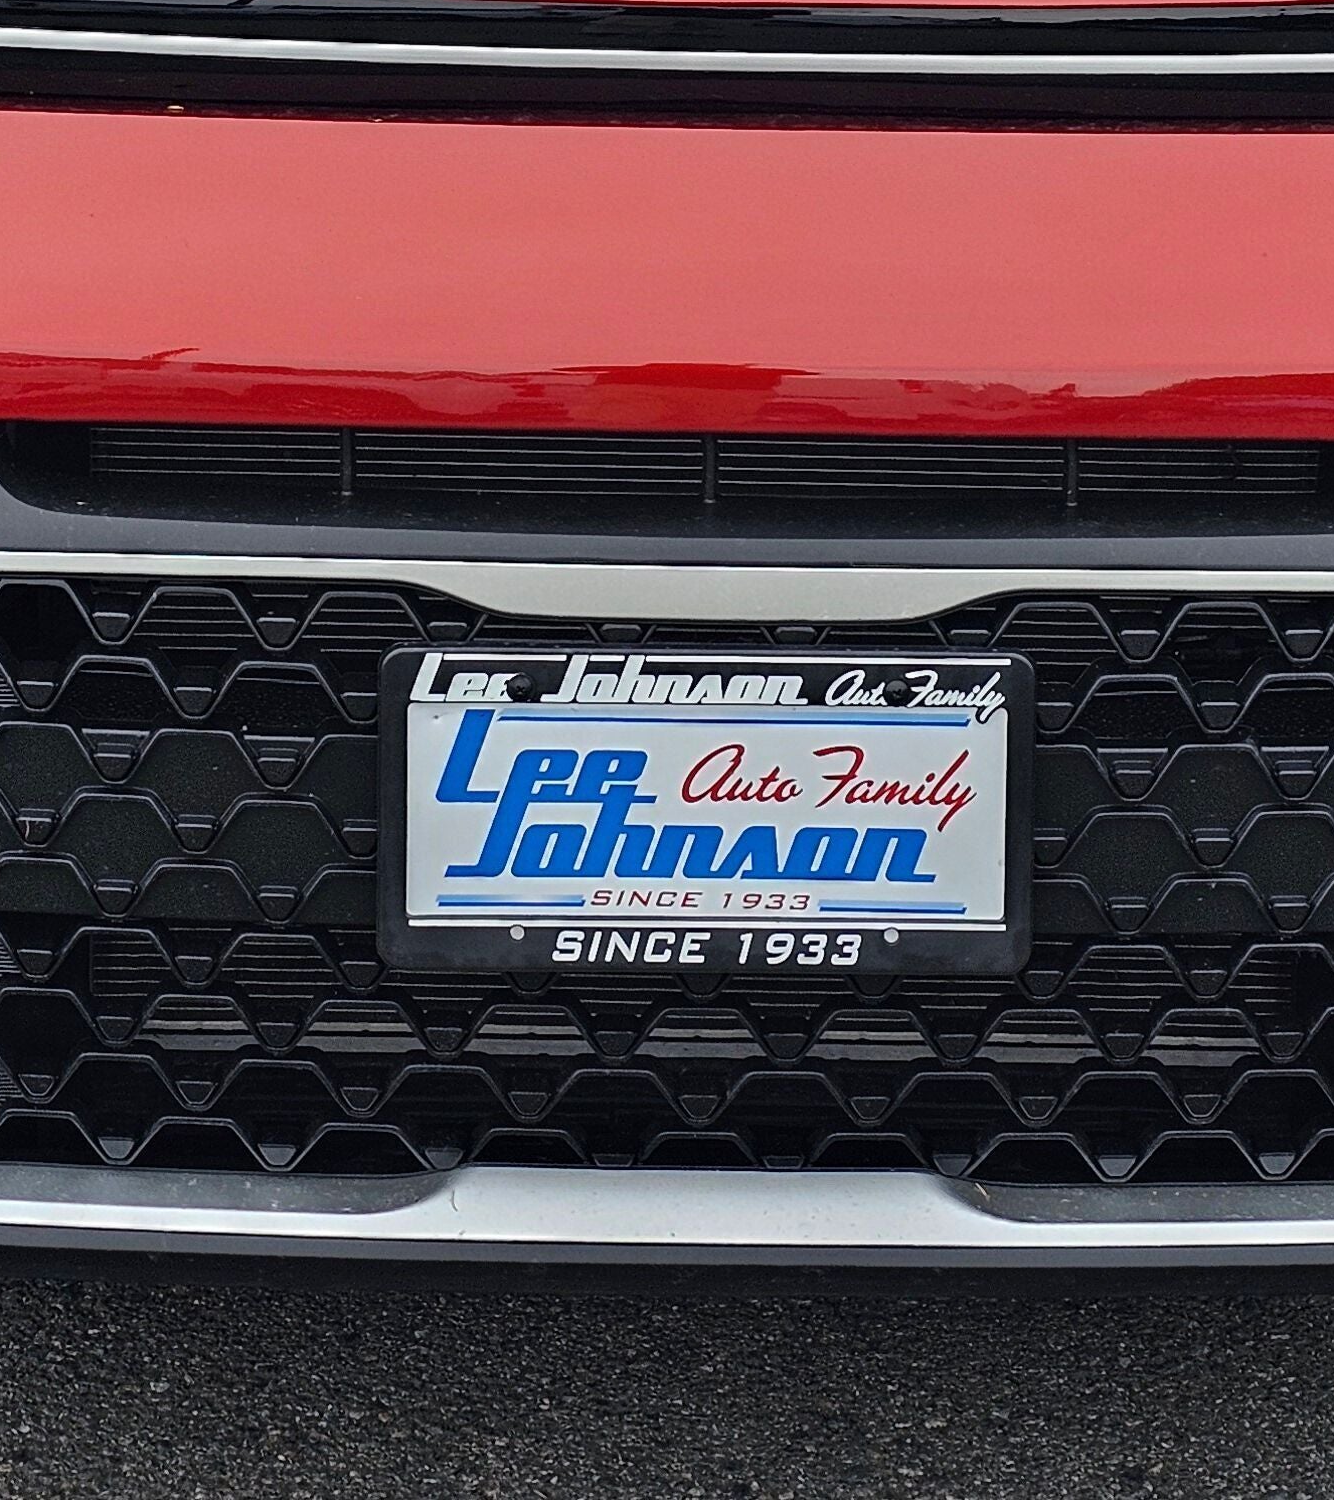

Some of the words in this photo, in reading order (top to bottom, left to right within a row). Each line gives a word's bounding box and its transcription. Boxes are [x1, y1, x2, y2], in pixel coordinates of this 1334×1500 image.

[540, 654, 808, 706] Johnson
[824, 668, 905, 707] Aut
[904, 669, 1006, 723] Family
[435, 708, 657, 803] Lee
[681, 743, 803, 804] Auto
[812, 745, 977, 832] Family
[444, 798, 937, 883] Johnson
[589, 890, 703, 908] SINCE
[723, 893, 811, 911] 1933
[551, 930, 711, 964] SINCE
[738, 932, 863, 966] 1933
